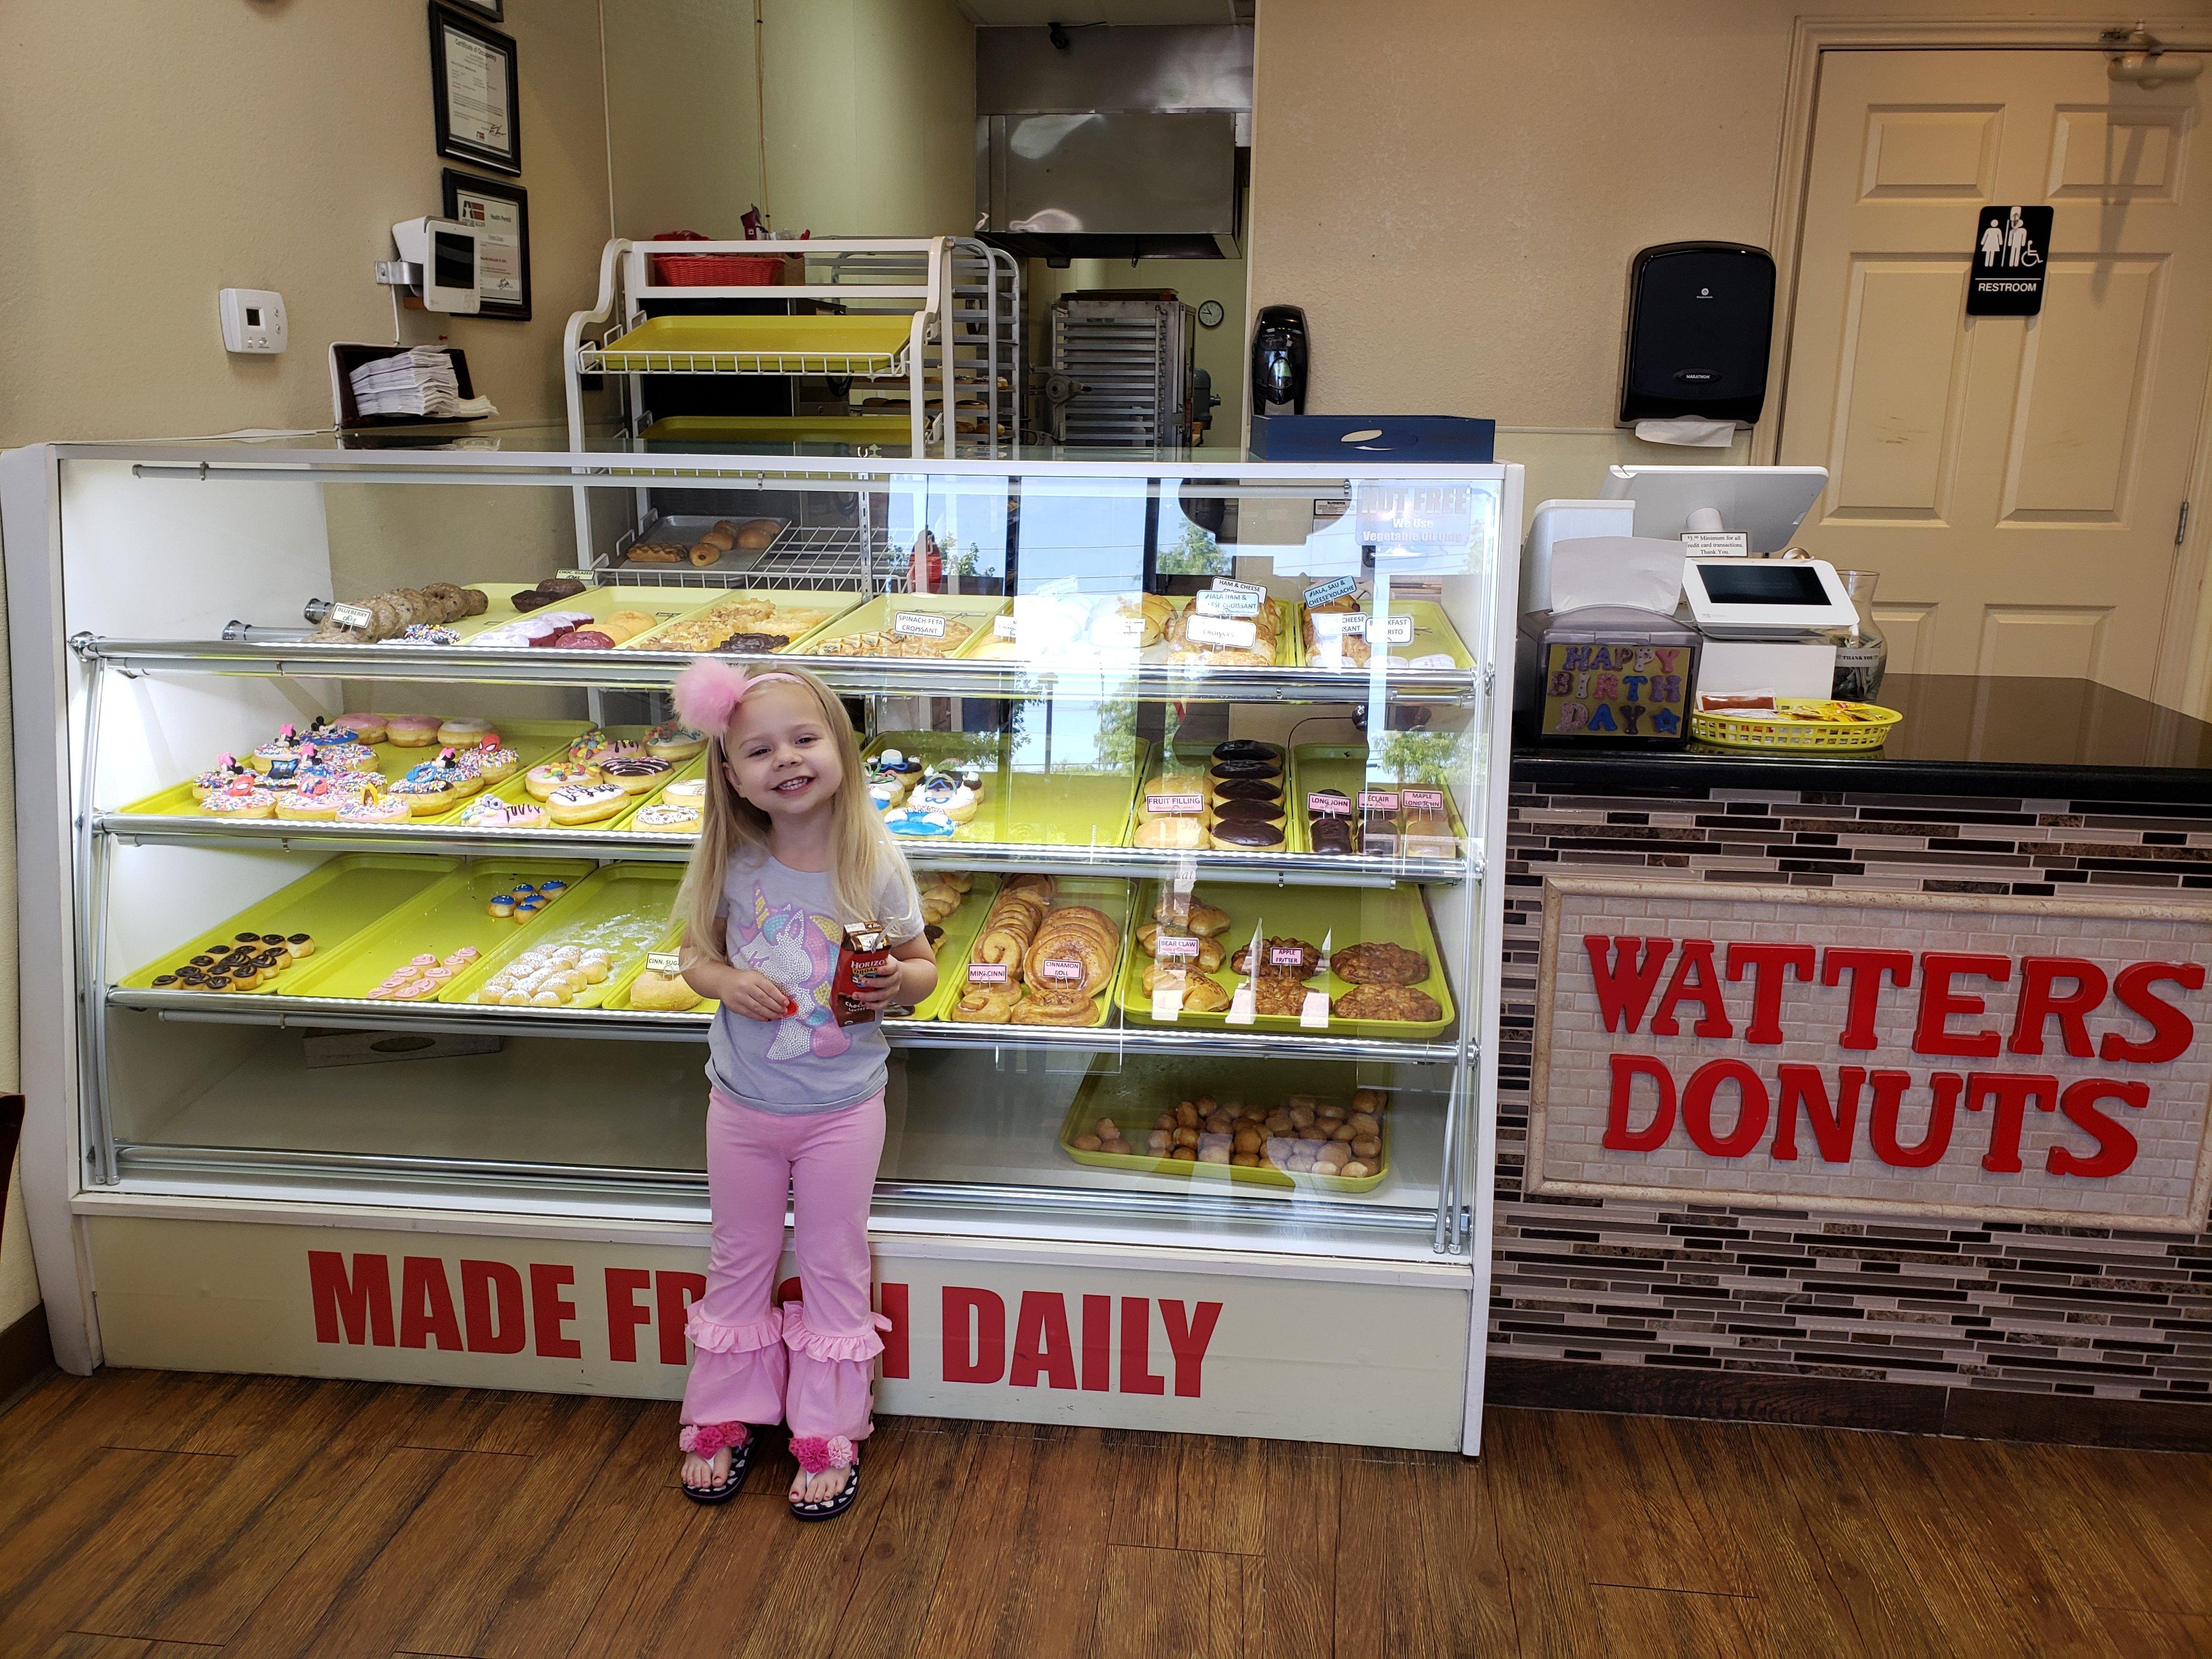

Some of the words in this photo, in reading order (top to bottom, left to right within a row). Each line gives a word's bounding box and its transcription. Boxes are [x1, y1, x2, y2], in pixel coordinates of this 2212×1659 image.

[1978, 283, 2037, 292] RESTROOM
[1361, 487, 1409, 514] NUT
[1413, 487, 1468, 514] FREE
[1392, 517, 1410, 529] We
[1413, 518, 1435, 528] Use
[1363, 531, 1418, 541] Vegetable
[1420, 531, 1435, 541] Oil
[1438, 532, 1462, 542] Only
[1240, 584, 1261, 592] CHEESE
[1312, 587, 1328, 597] JALA,
[1328, 581, 1340, 590] SAU
[1308, 595, 1329, 606] CHEESE
[1329, 584, 1355, 599] KOLACHE
[337, 607, 368, 618] BLUEBERRY
[899, 615, 926, 624] SPINACH
[902, 624, 938, 634] CROISSANT
[1562, 645, 1680, 674] HAPPY
[1548, 670, 1682, 703] BIRTH
[1556, 702, 1646, 735] DAY
[1311, 797, 1329, 805] LONG
[1368, 794, 1389, 803] ÉCLAIR
[850, 959, 886, 969] HORIZO
[1583, 935, 2206, 1064] WATTERS
[1602, 1053, 2150, 1178] DONUTS
[308, 1250, 582, 1359] MADE
[605, 1268, 910, 1379] FR
[942, 1286, 1223, 1398] DAILY
